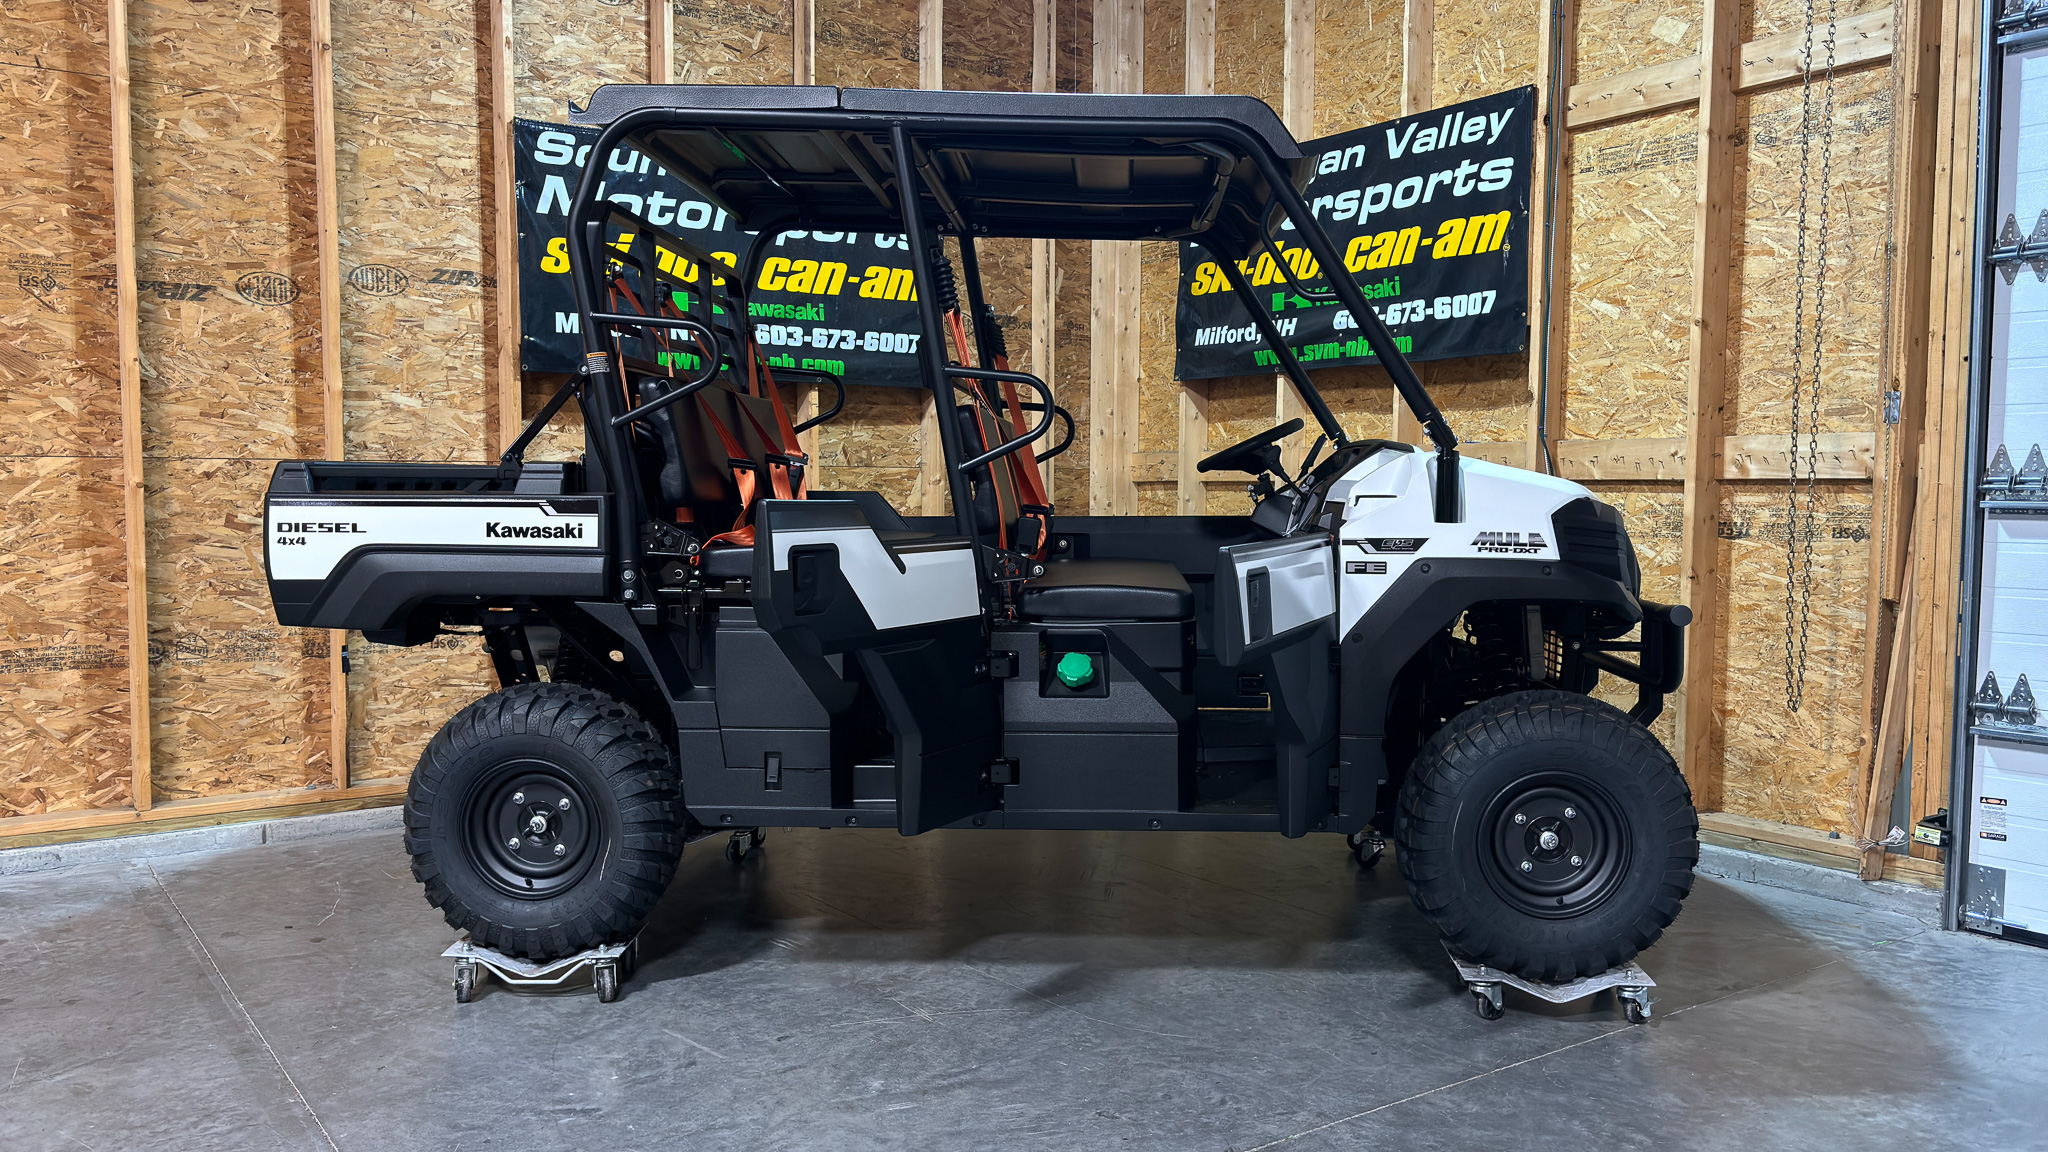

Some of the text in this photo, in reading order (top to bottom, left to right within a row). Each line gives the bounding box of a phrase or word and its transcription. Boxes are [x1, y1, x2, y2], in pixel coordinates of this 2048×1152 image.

[1386, 107, 1515, 160] Valley
[1343, 210, 1511, 274] can-am
[755, 323, 921, 354] 603-673-6007
[1195, 322, 1262, 346] Milford,
[277, 522, 583, 539] DIESEL Kawasaki
[277, 536, 307, 546] 4x4
[1470, 531, 1548, 548] MULE
[1477, 546, 1542, 554] PRO-DXT
[1347, 562, 1387, 574] FE
